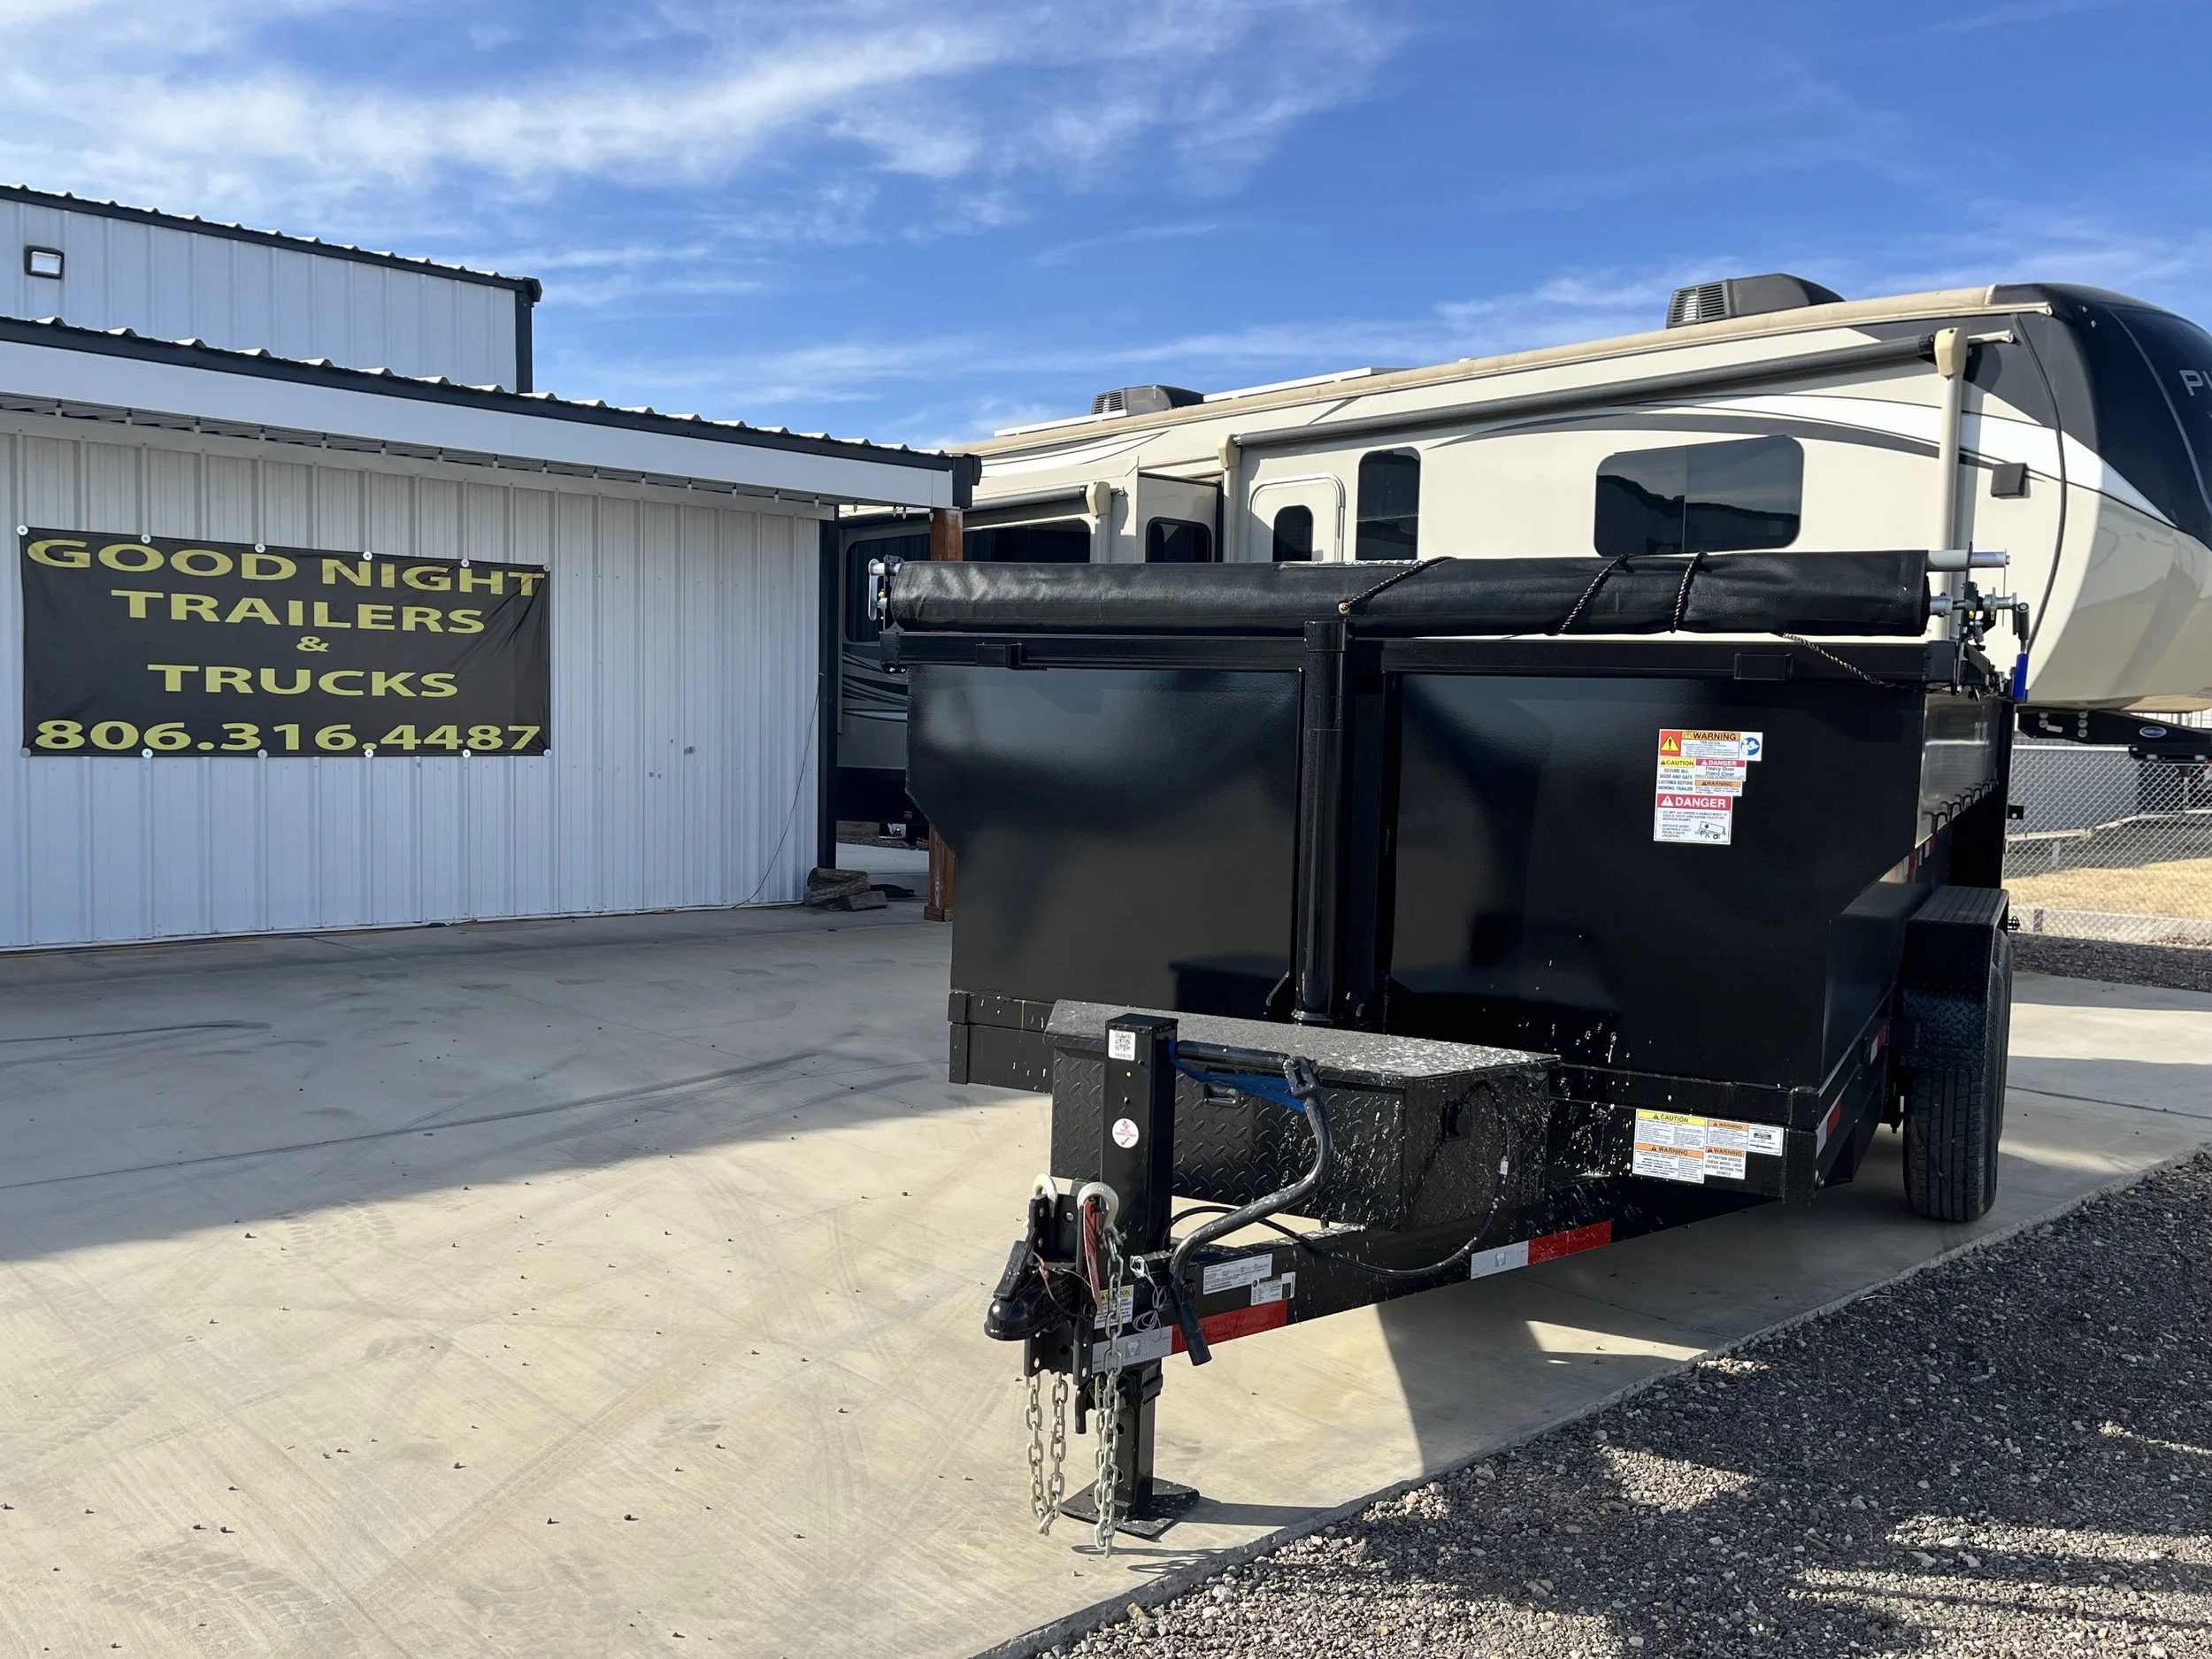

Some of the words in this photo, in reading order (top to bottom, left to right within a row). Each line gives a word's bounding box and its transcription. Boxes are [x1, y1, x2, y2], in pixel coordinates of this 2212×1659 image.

[27, 540, 296, 580] GOOD
[322, 558, 545, 596] NIGHT
[111, 589, 485, 634] TRAILERS
[296, 635, 329, 653] &
[147, 664, 458, 698] TRUCKS
[35, 719, 541, 751] 806.316.4487
[1694, 732, 1736, 741] WARNING
[1675, 796, 1726, 808] DANGER
[1660, 1114, 1689, 1123] CAUTION
[1659, 1146, 1688, 1156] WARNING
[1713, 1148, 1743, 1157] WARNING
